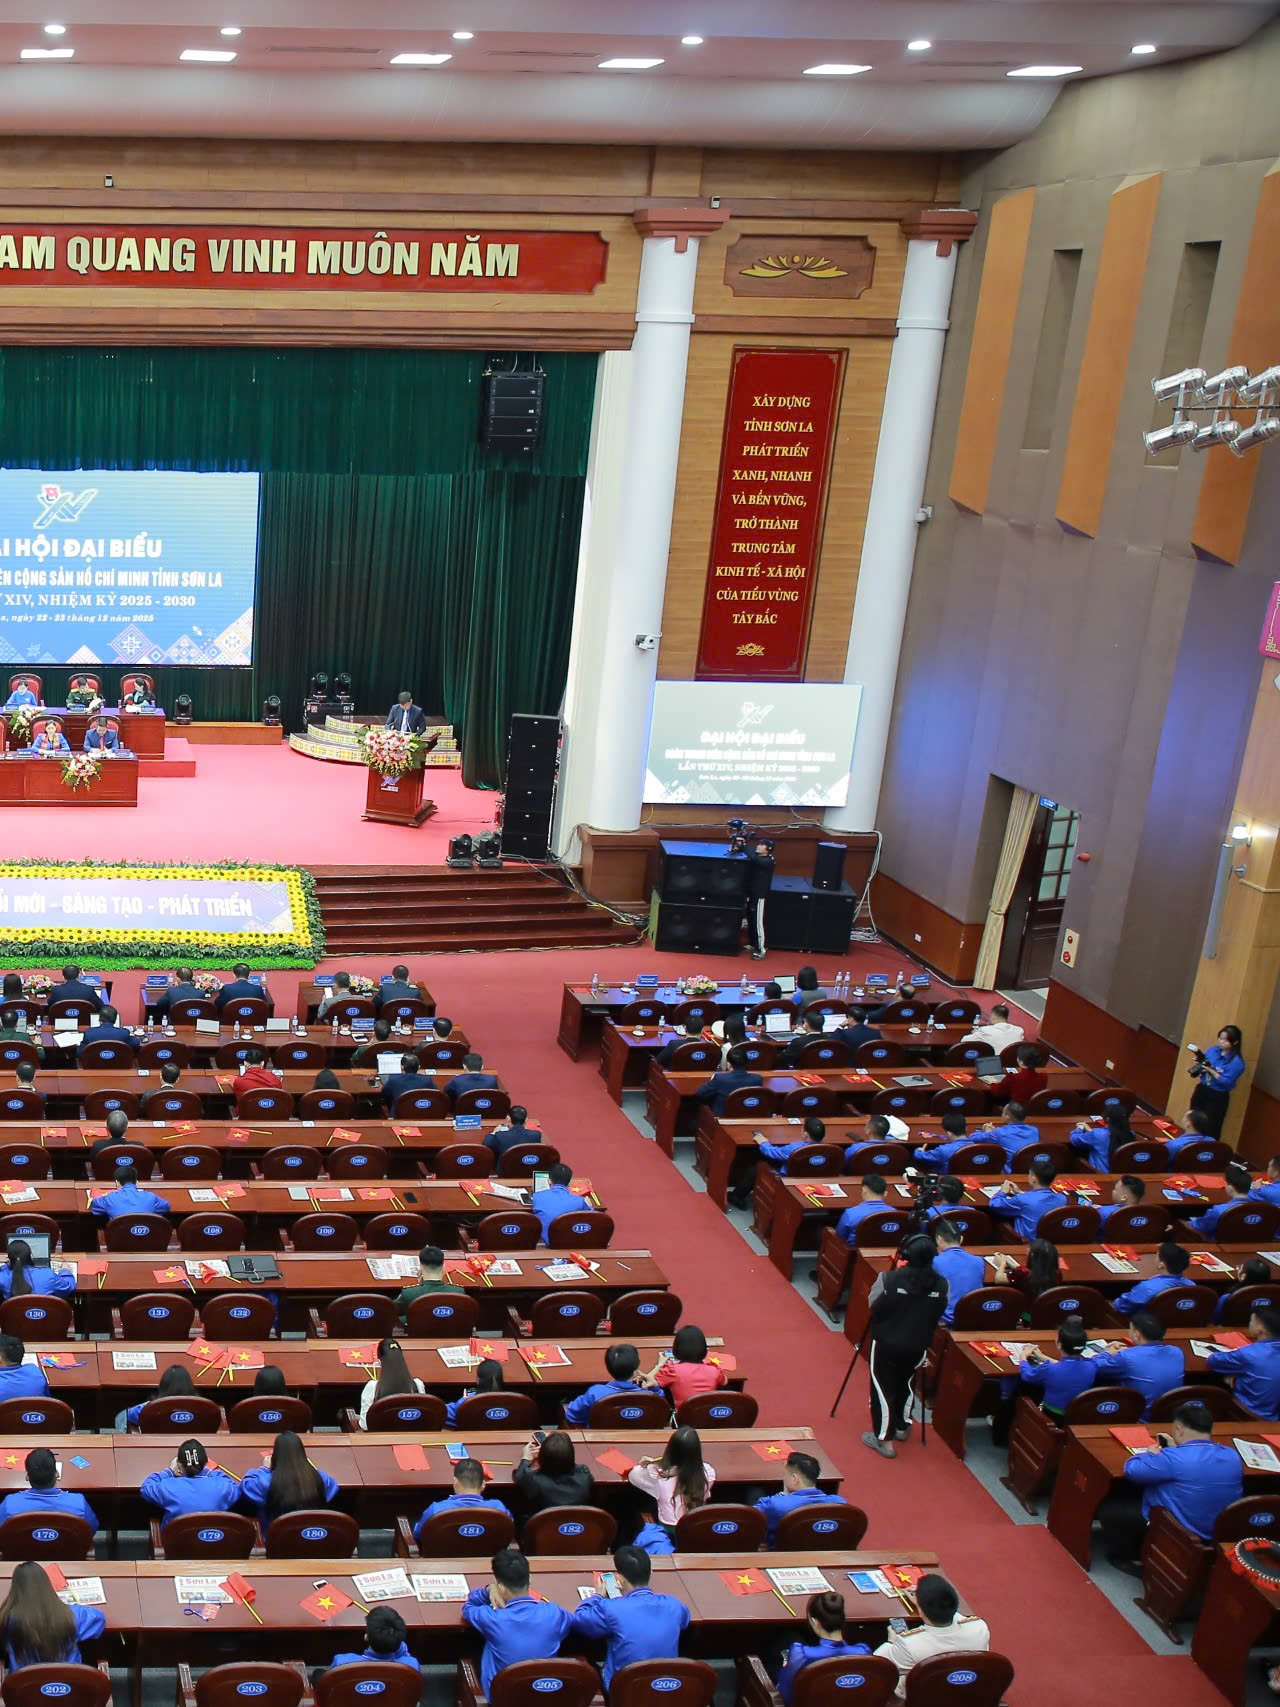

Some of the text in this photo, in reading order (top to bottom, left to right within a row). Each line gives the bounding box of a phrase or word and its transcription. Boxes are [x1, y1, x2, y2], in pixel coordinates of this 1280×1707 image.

[66, 236, 196, 274] QUANG
[207, 239, 296, 273] VINH
[306, 231, 419, 276] MUÔN
[429, 234, 519, 277] NĂM
[752, 393, 811, 410] XÂY DỰNG
[744, 417, 814, 433] TỈNH SƠN LA
[742, 442, 809, 457] PHÁT TRIỂN
[732, 469, 812, 483] XANH, NHANH
[732, 491, 747, 505] VÀ
[773, 492, 807, 507] VỮNG,
[734, 515, 799, 530] TRỞ THÀNH
[15, 533, 59, 563] HỘI
[63, 538, 105, 563] ĐẠI
[109, 531, 162, 558] BIỂU
[731, 540, 797, 554] TRUNG TÂM
[14, 567, 47, 589] CỘNG
[49, 566, 74, 586] SẢN
[94, 568, 115, 587] CHÍ
[117, 570, 149, 587] MINH
[152, 566, 179, 588] TỈNH
[181, 571, 206, 588] SƠN
[208, 572, 222, 588] LA
[715, 566, 745, 577] KINH
[746, 562, 761, 577] TẾ
[766, 565, 783, 578] XÃ
[784, 565, 806, 580] HỘI
[4, 594, 34, 608] XIV,
[38, 591, 92, 608] NHIỆM
[96, 592, 117, 606] KỲ
[119, 595, 152, 607] 2025
[163, 595, 196, 607] 2030
[716, 585, 799, 601] CỦA TIỂU VÙNG
[732, 608, 778, 624] TÂY BẮC
[111, 896, 144, 918] TẠO
[157, 894, 201, 916] PHÁT
[204, 891, 253, 917] TRIỂN
[174, 1413, 191, 1421] 155
[401, 1410, 418, 1419] 157
[713, 1408, 729, 1416] 160
[816, 1522, 835, 1531] 184
[655, 1680, 677, 1689] 206
[840, 1677, 861, 1686] 207
[951, 1673, 973, 1682] 208
[45, 1685, 68, 1694] 202
[241, 1684, 263, 1693] 203
[359, 1683, 382, 1692] 204
[536, 1680, 559, 1690] 205
